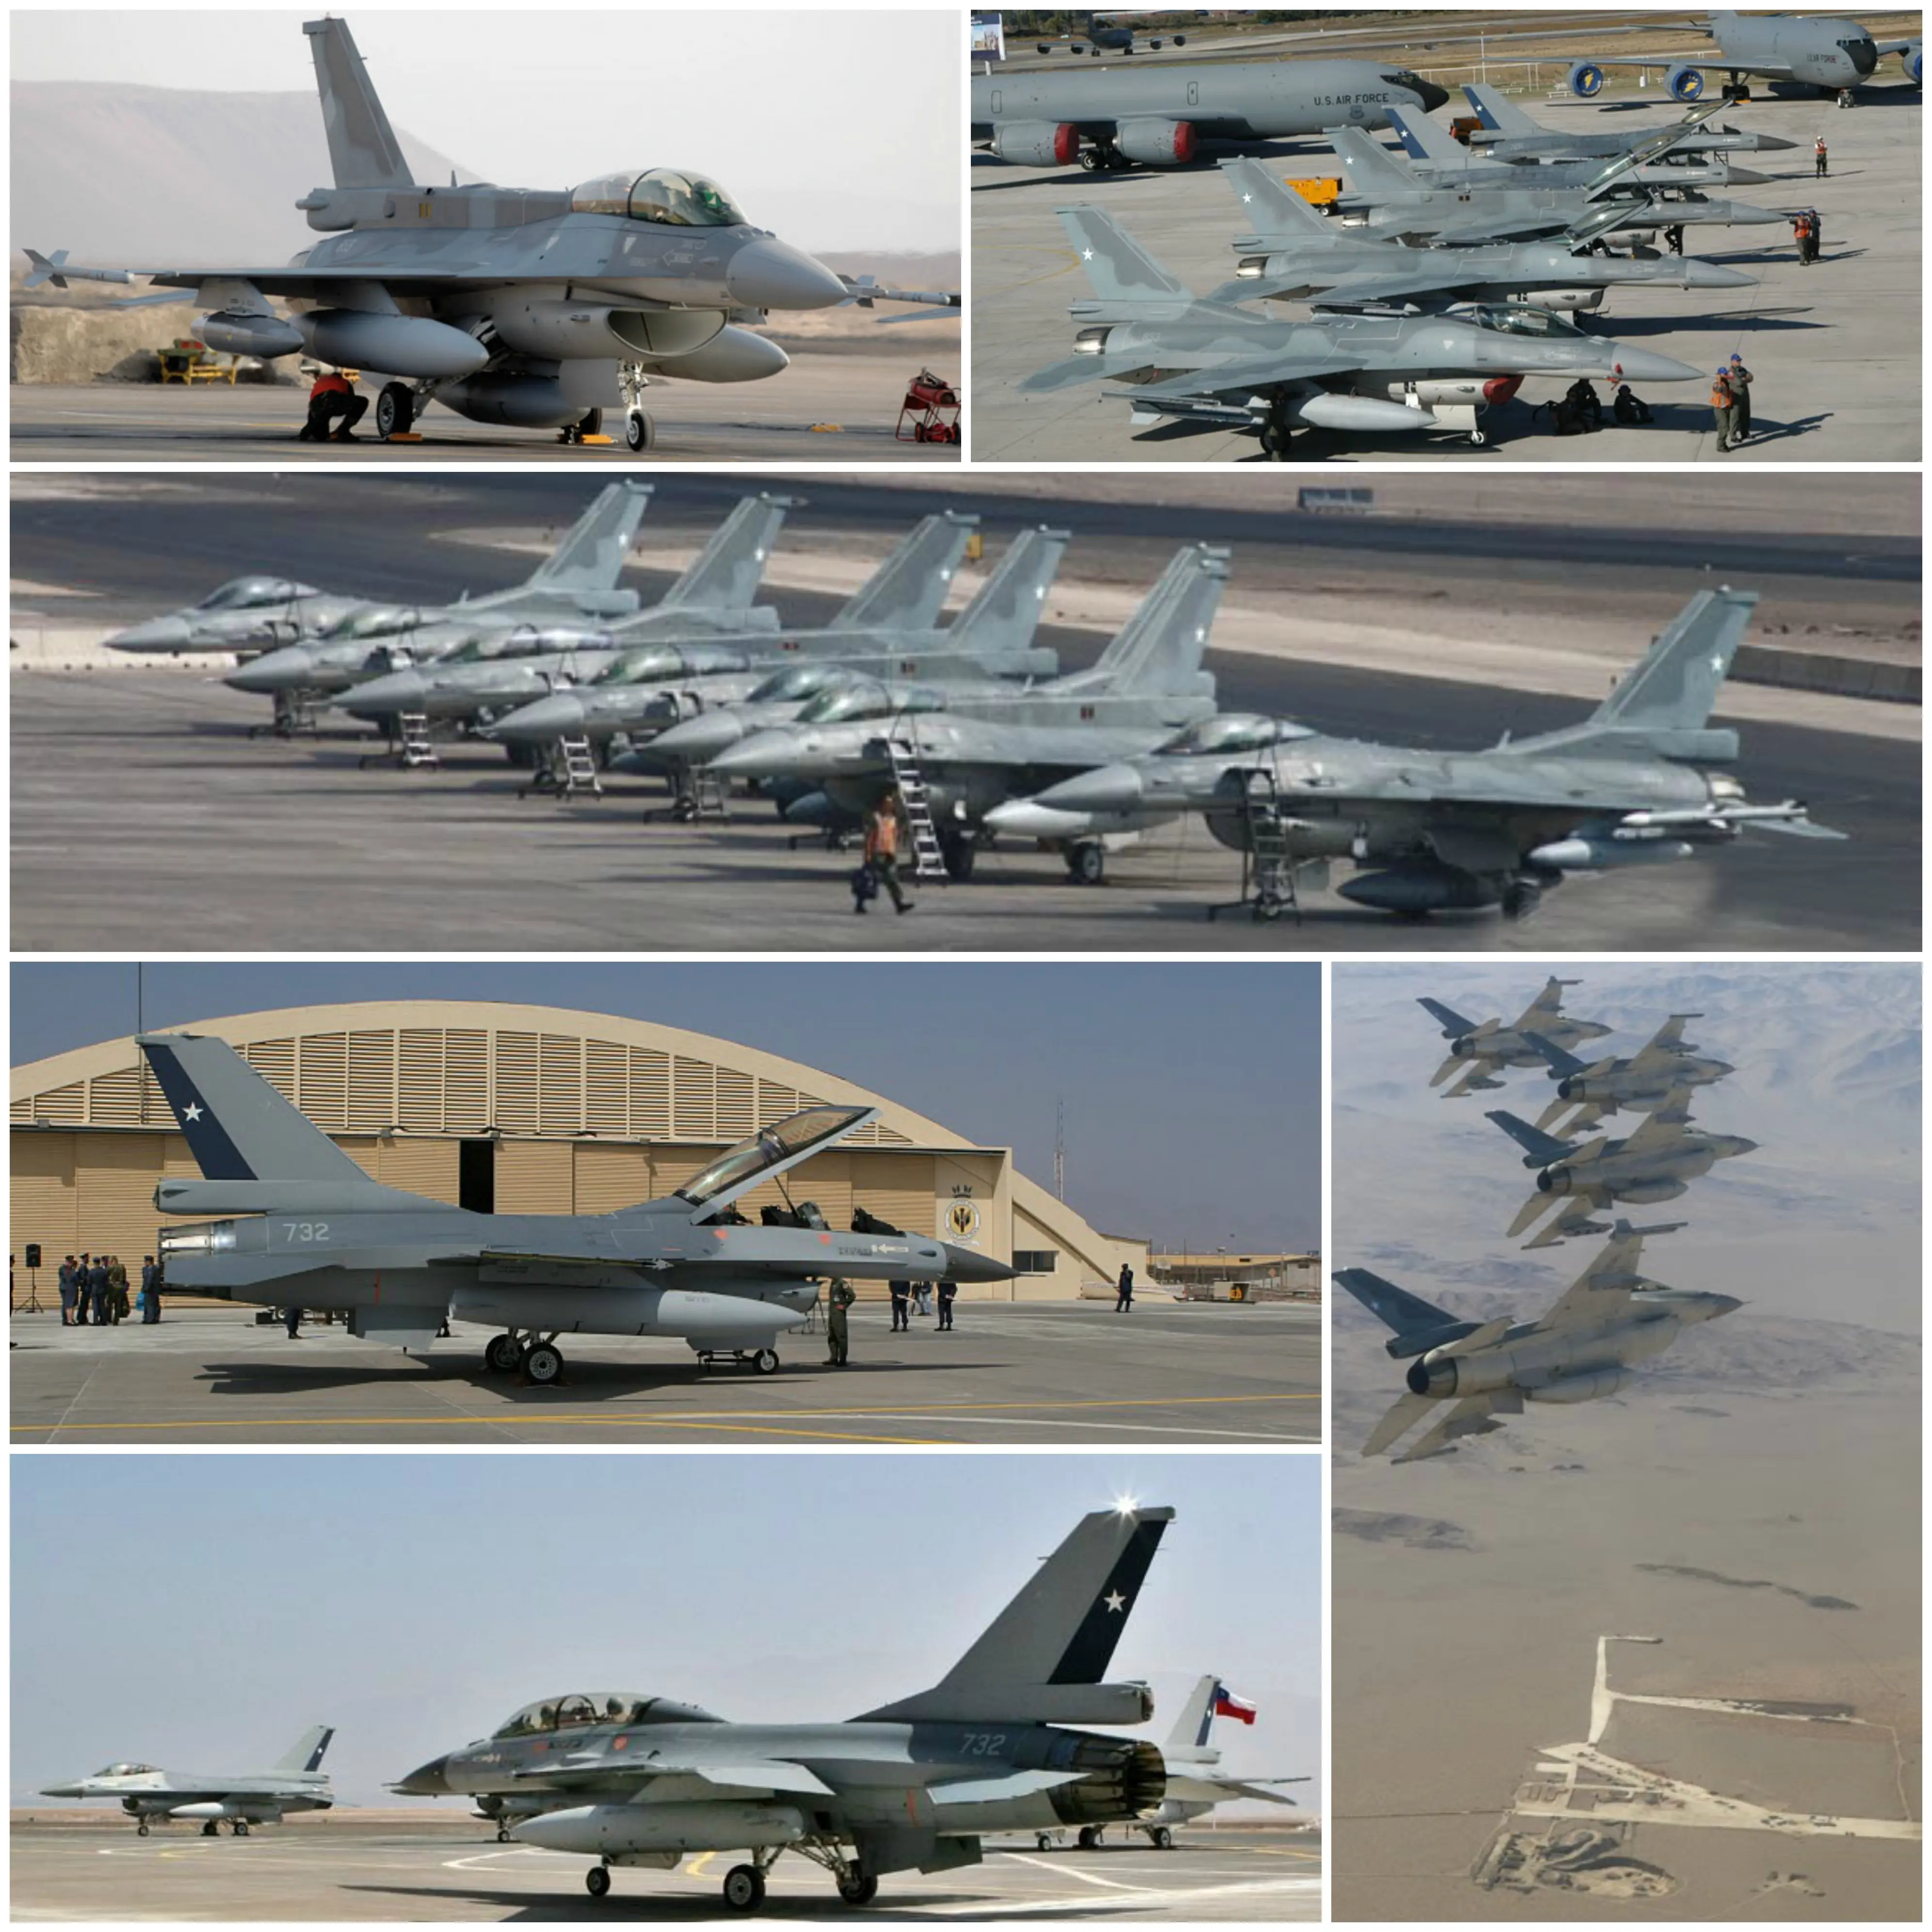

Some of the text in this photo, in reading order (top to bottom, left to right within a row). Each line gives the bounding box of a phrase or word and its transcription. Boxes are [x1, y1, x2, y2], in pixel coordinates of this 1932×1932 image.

[1336, 95, 1352, 105] AIR
[1355, 93, 1389, 104] FORCE
[282, 1223, 329, 1242] 732
[960, 1734, 1006, 1755] 732
